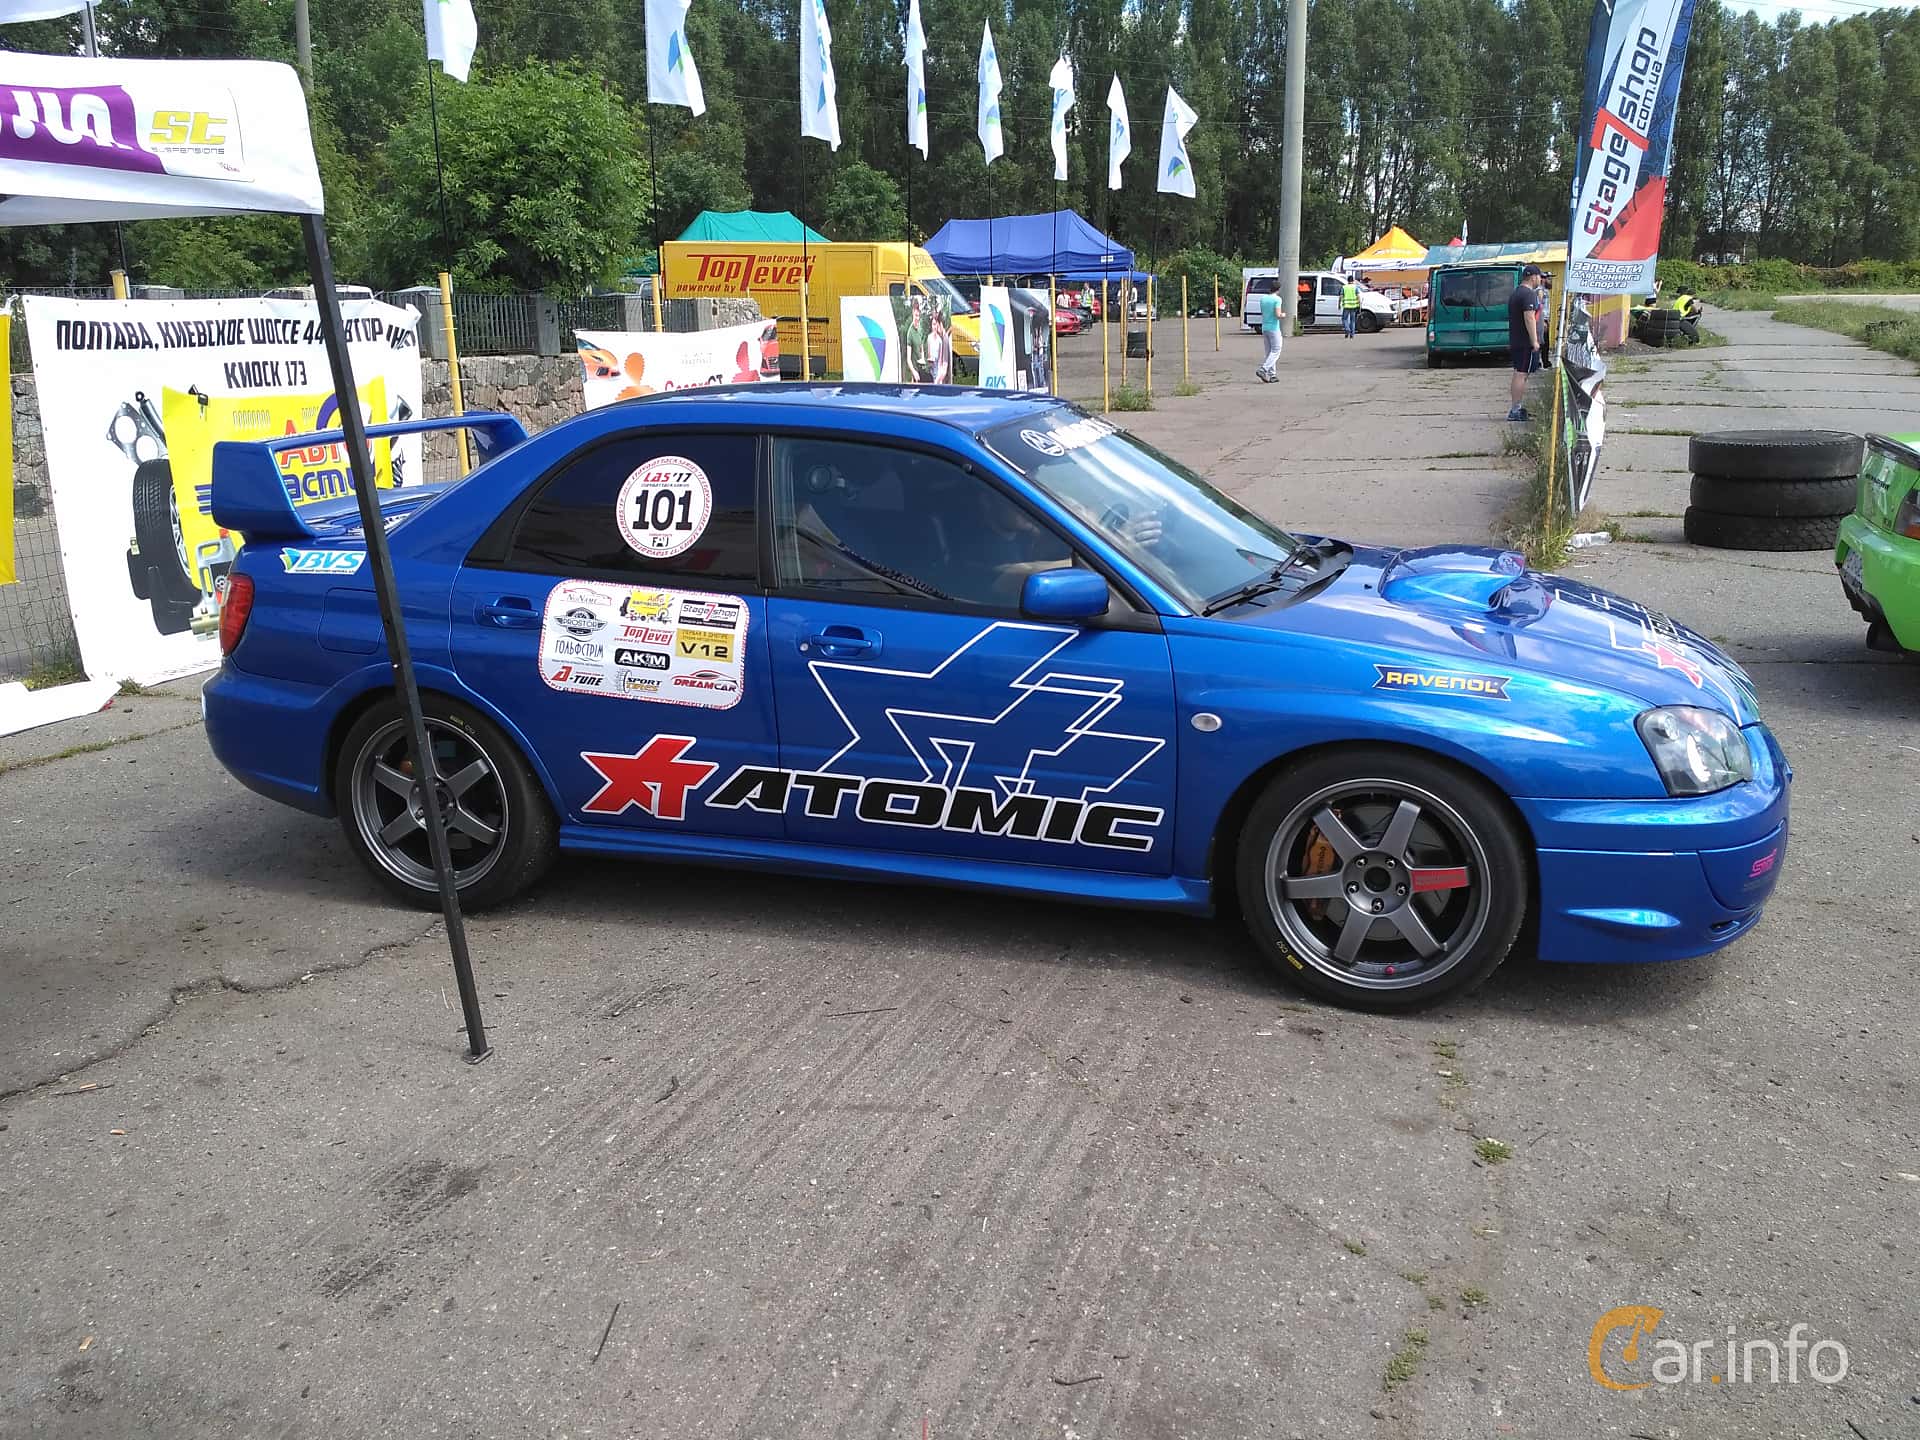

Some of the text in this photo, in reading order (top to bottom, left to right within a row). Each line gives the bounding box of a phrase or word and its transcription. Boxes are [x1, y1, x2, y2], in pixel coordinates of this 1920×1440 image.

[676, 283, 736, 293] powered by
[56, 318, 160, 351] ПОЛТАВА,
[157, 318, 245, 349] КИЕВСКОЕ
[249, 318, 299, 346] ШОССЕ
[223, 360, 308, 389] КИОСК 173
[632, 489, 692, 531] 101
[298, 551, 364, 568] BVS
[680, 641, 728, 659] V12
[1386, 671, 1498, 693] RAVENOL
[705, 766, 1164, 852] ATOMIC
